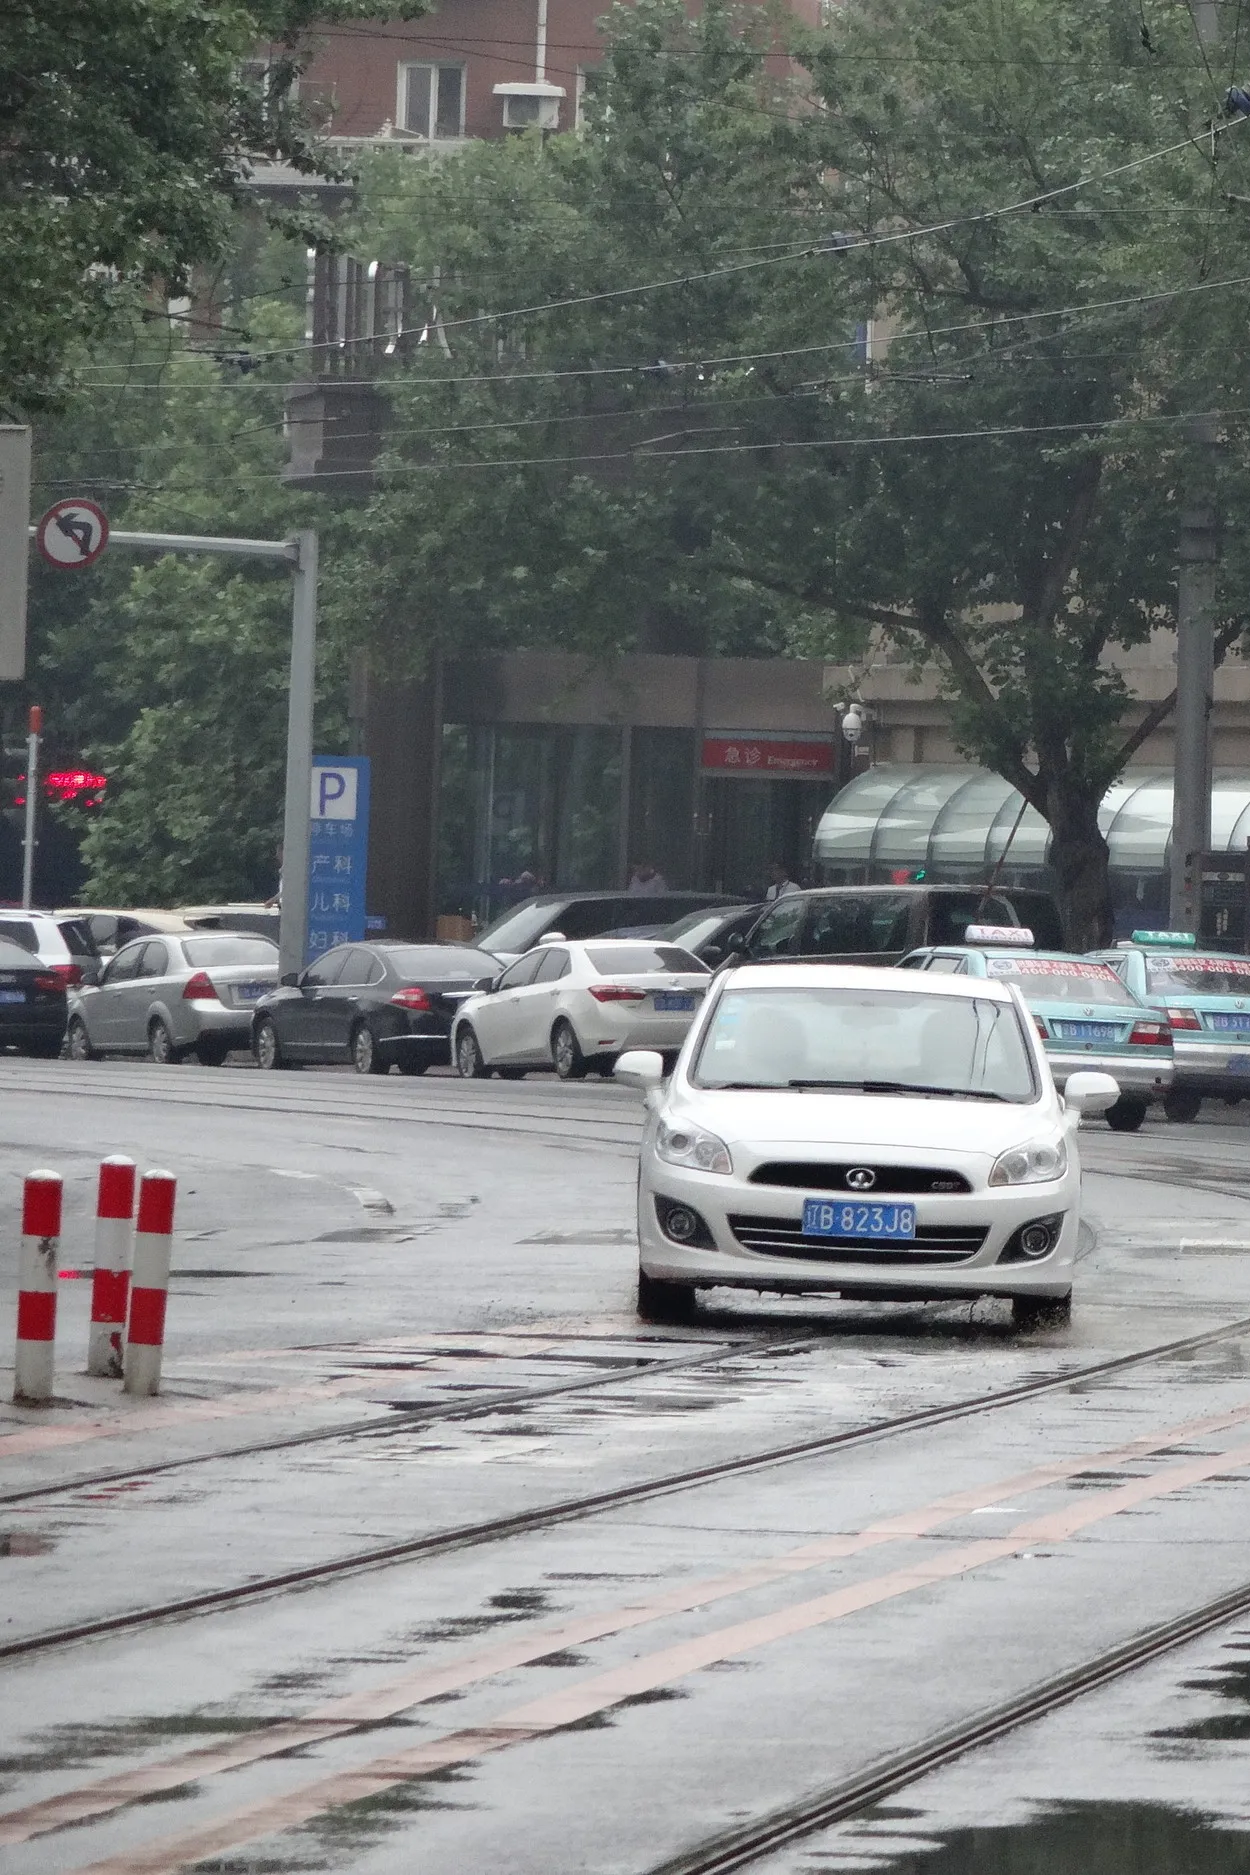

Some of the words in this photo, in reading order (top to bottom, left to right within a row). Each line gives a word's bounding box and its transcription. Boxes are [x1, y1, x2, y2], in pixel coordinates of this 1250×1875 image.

[319, 772, 346, 816] P
[312, 855, 352, 875] 产科
[311, 892, 350, 912] 儿科
